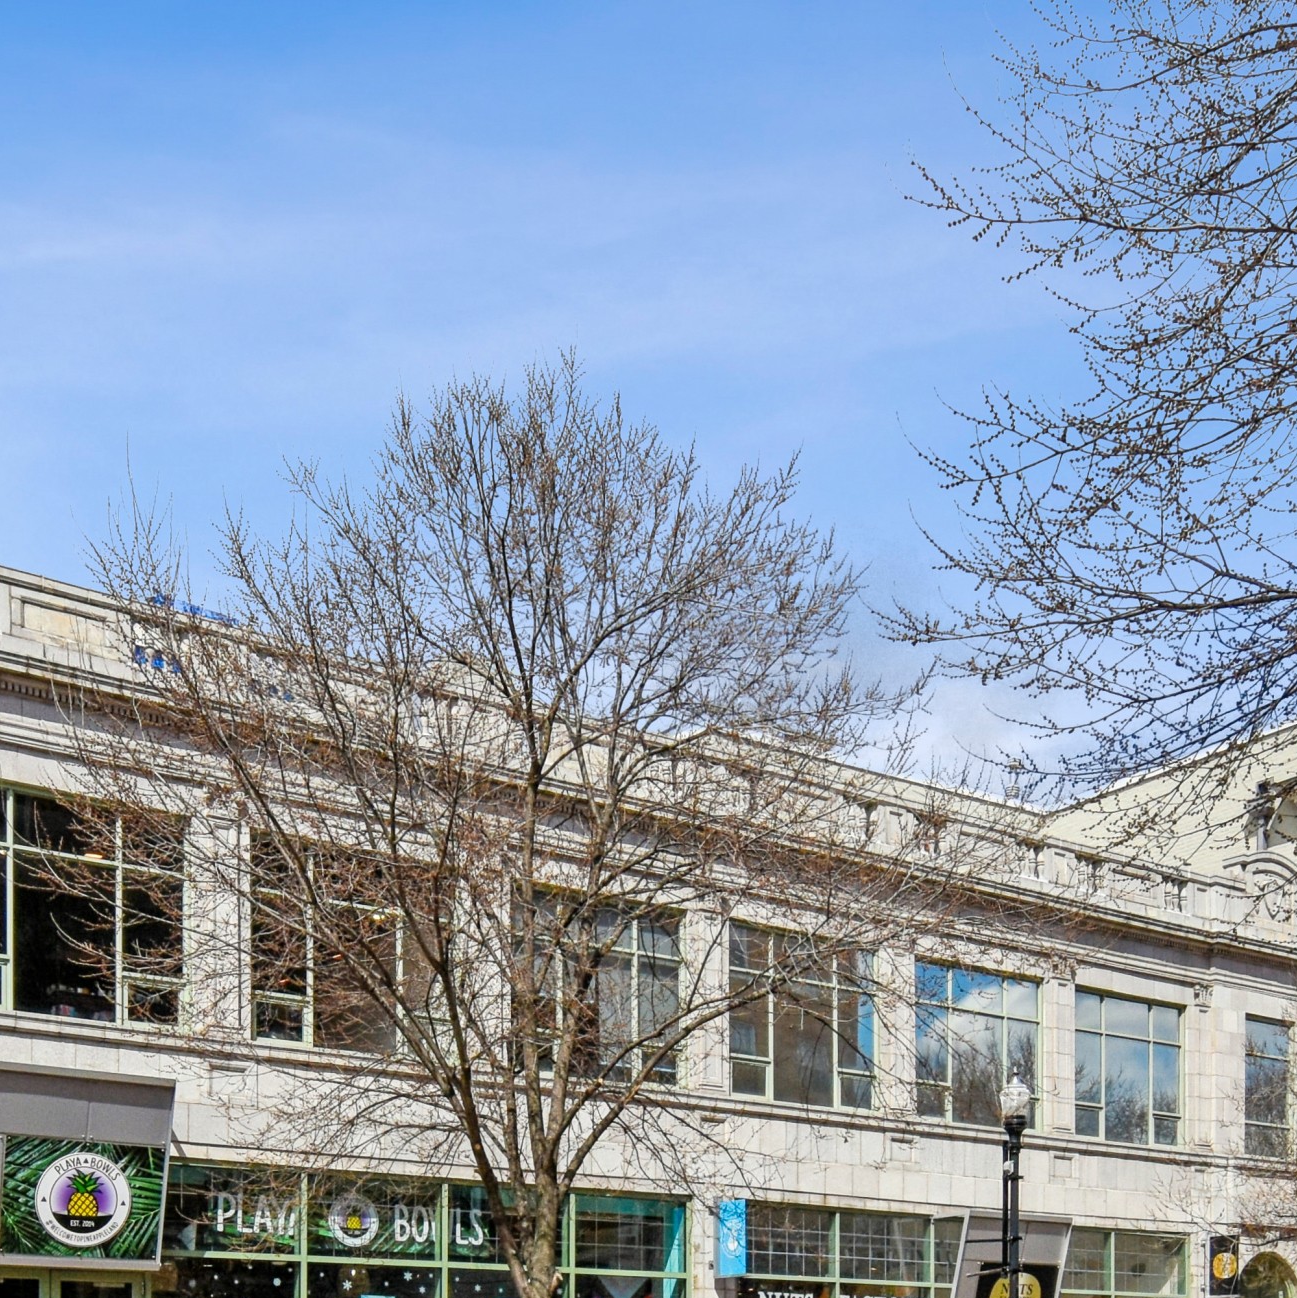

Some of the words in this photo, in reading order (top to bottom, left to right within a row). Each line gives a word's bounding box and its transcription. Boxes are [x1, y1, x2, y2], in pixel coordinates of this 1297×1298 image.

[53, 1156, 82, 1175] PLAYA
[89, 1157, 121, 1181] BOWLS
[1000, 1282, 1034, 1295] NTS
